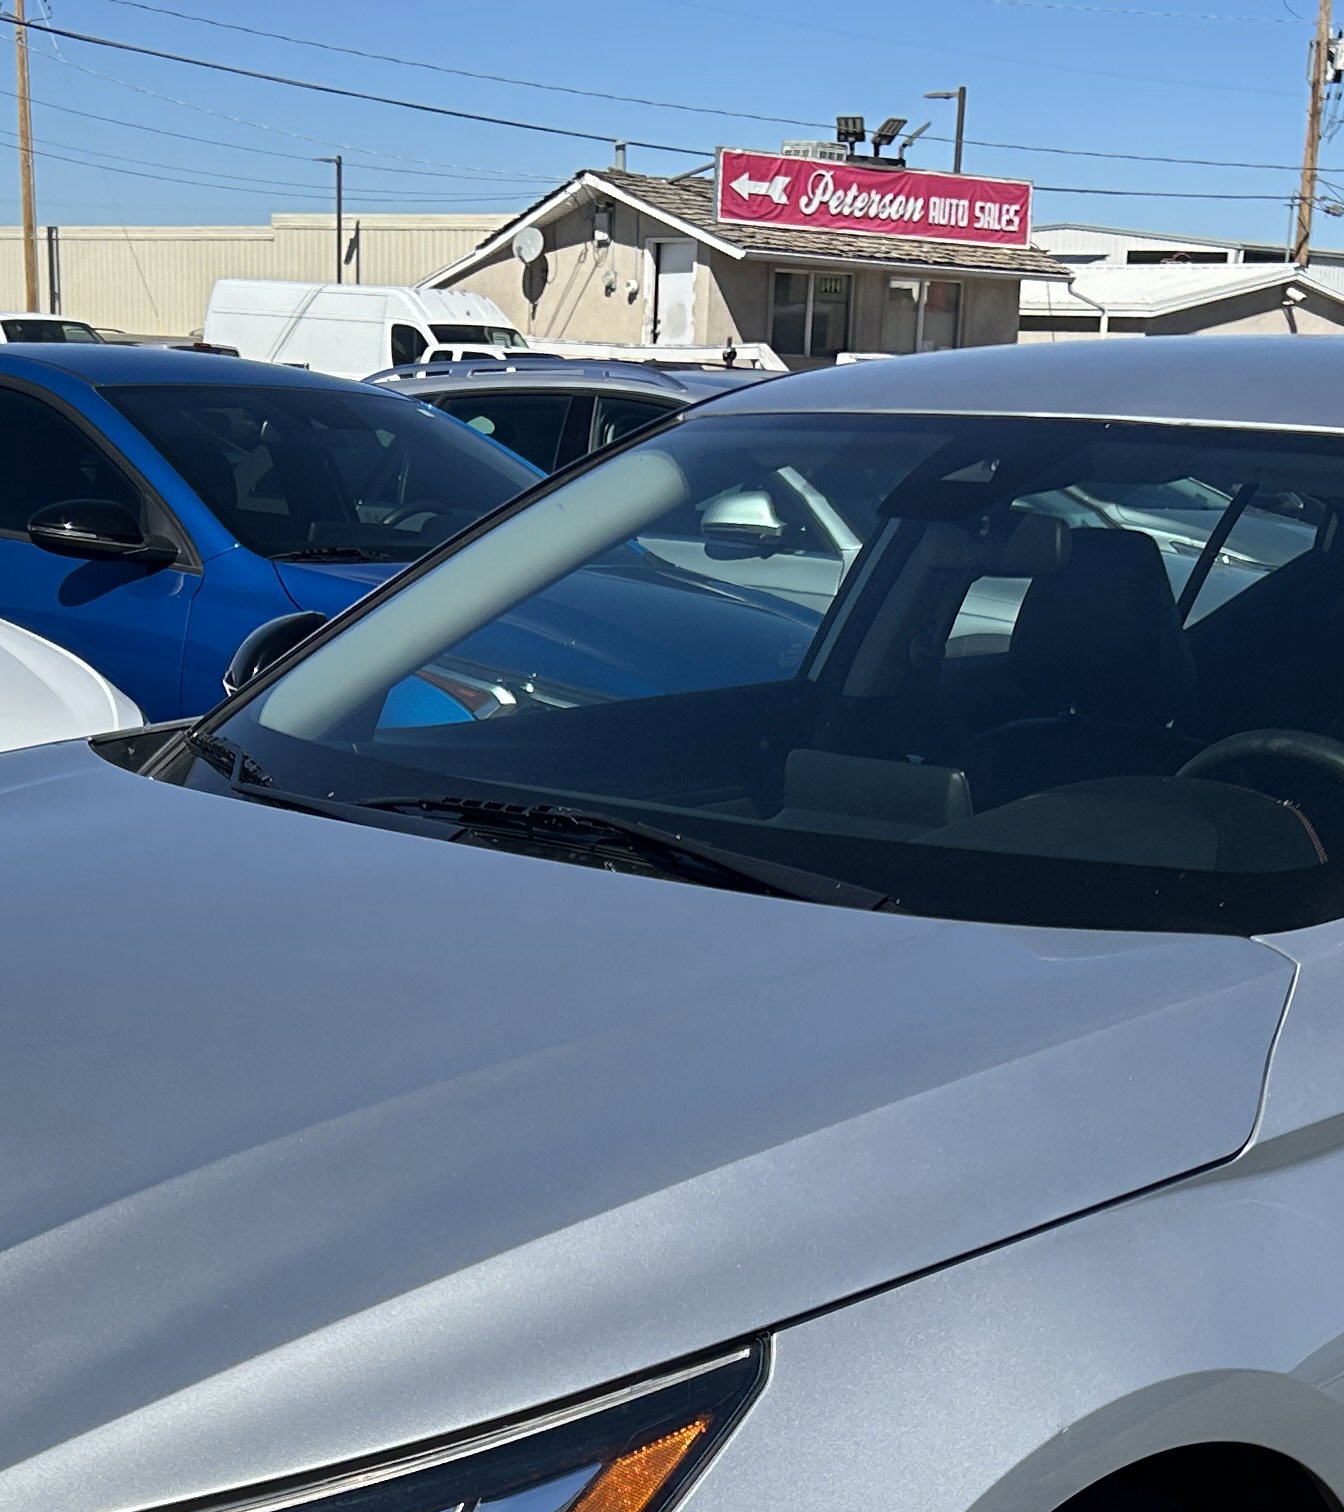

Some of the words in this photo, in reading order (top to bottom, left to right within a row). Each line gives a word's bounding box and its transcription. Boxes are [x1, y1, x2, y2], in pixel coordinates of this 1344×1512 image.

[799, 169, 925, 223] Peterson
[928, 197, 969, 227] AUTO
[973, 201, 1021, 232] SALES
